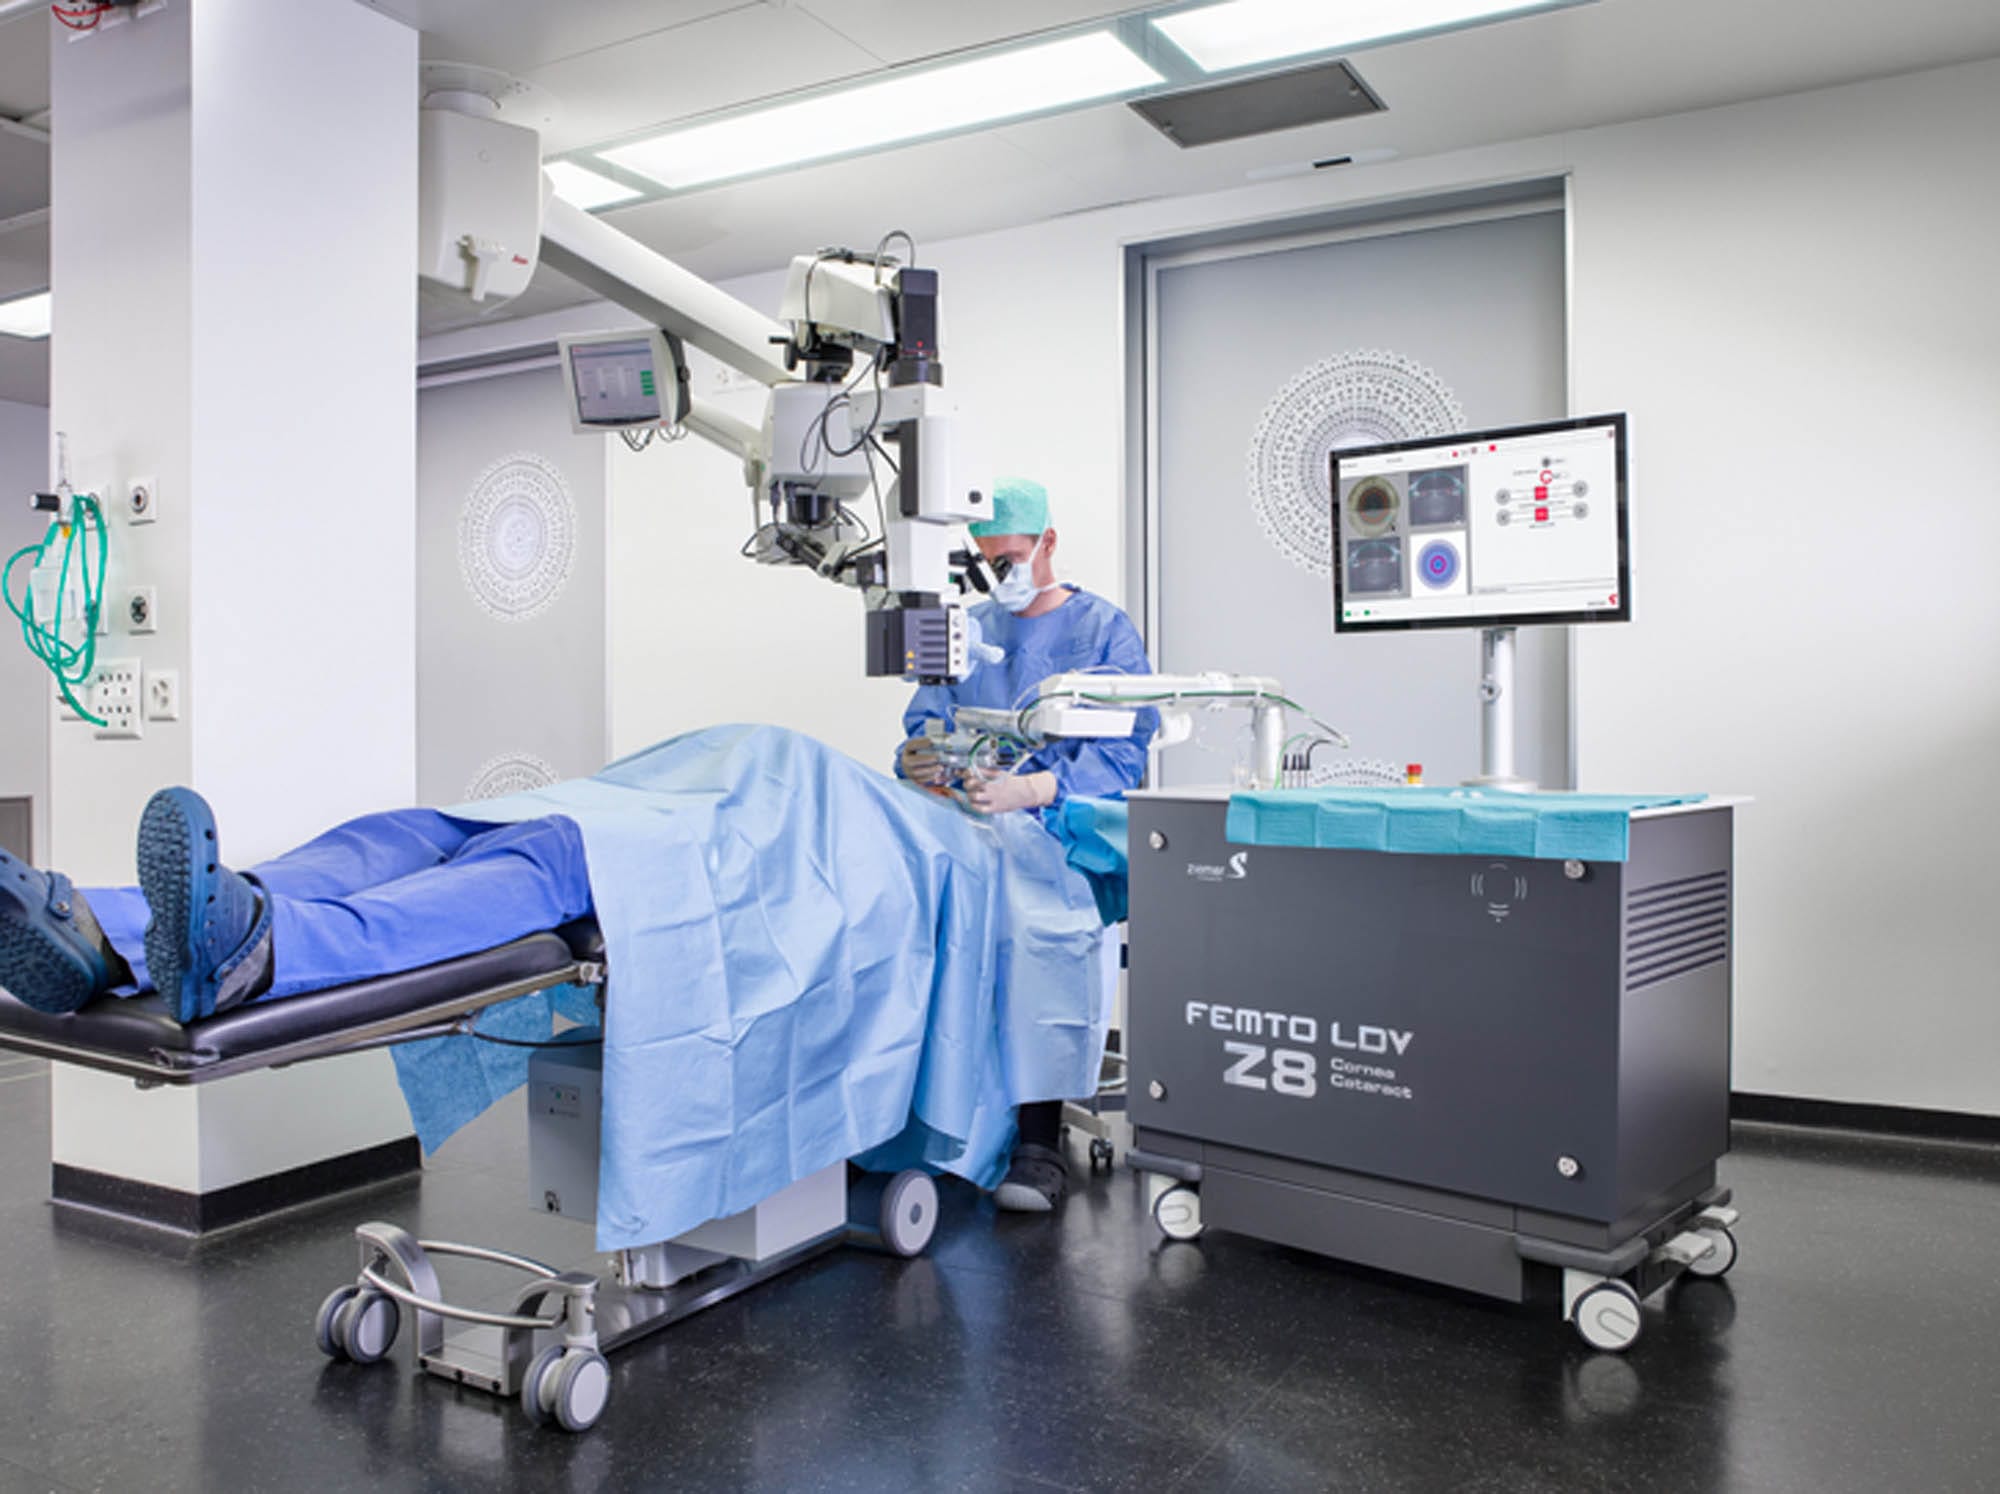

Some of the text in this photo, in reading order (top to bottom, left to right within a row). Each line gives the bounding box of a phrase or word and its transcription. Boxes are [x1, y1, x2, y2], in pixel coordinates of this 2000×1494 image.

[1185, 1000, 1414, 1056] FEMTO LDV
[1223, 1040, 1317, 1098] Z8
[1330, 1057, 1396, 1079] Cornea
[1330, 1073, 1413, 1099] Cataract
